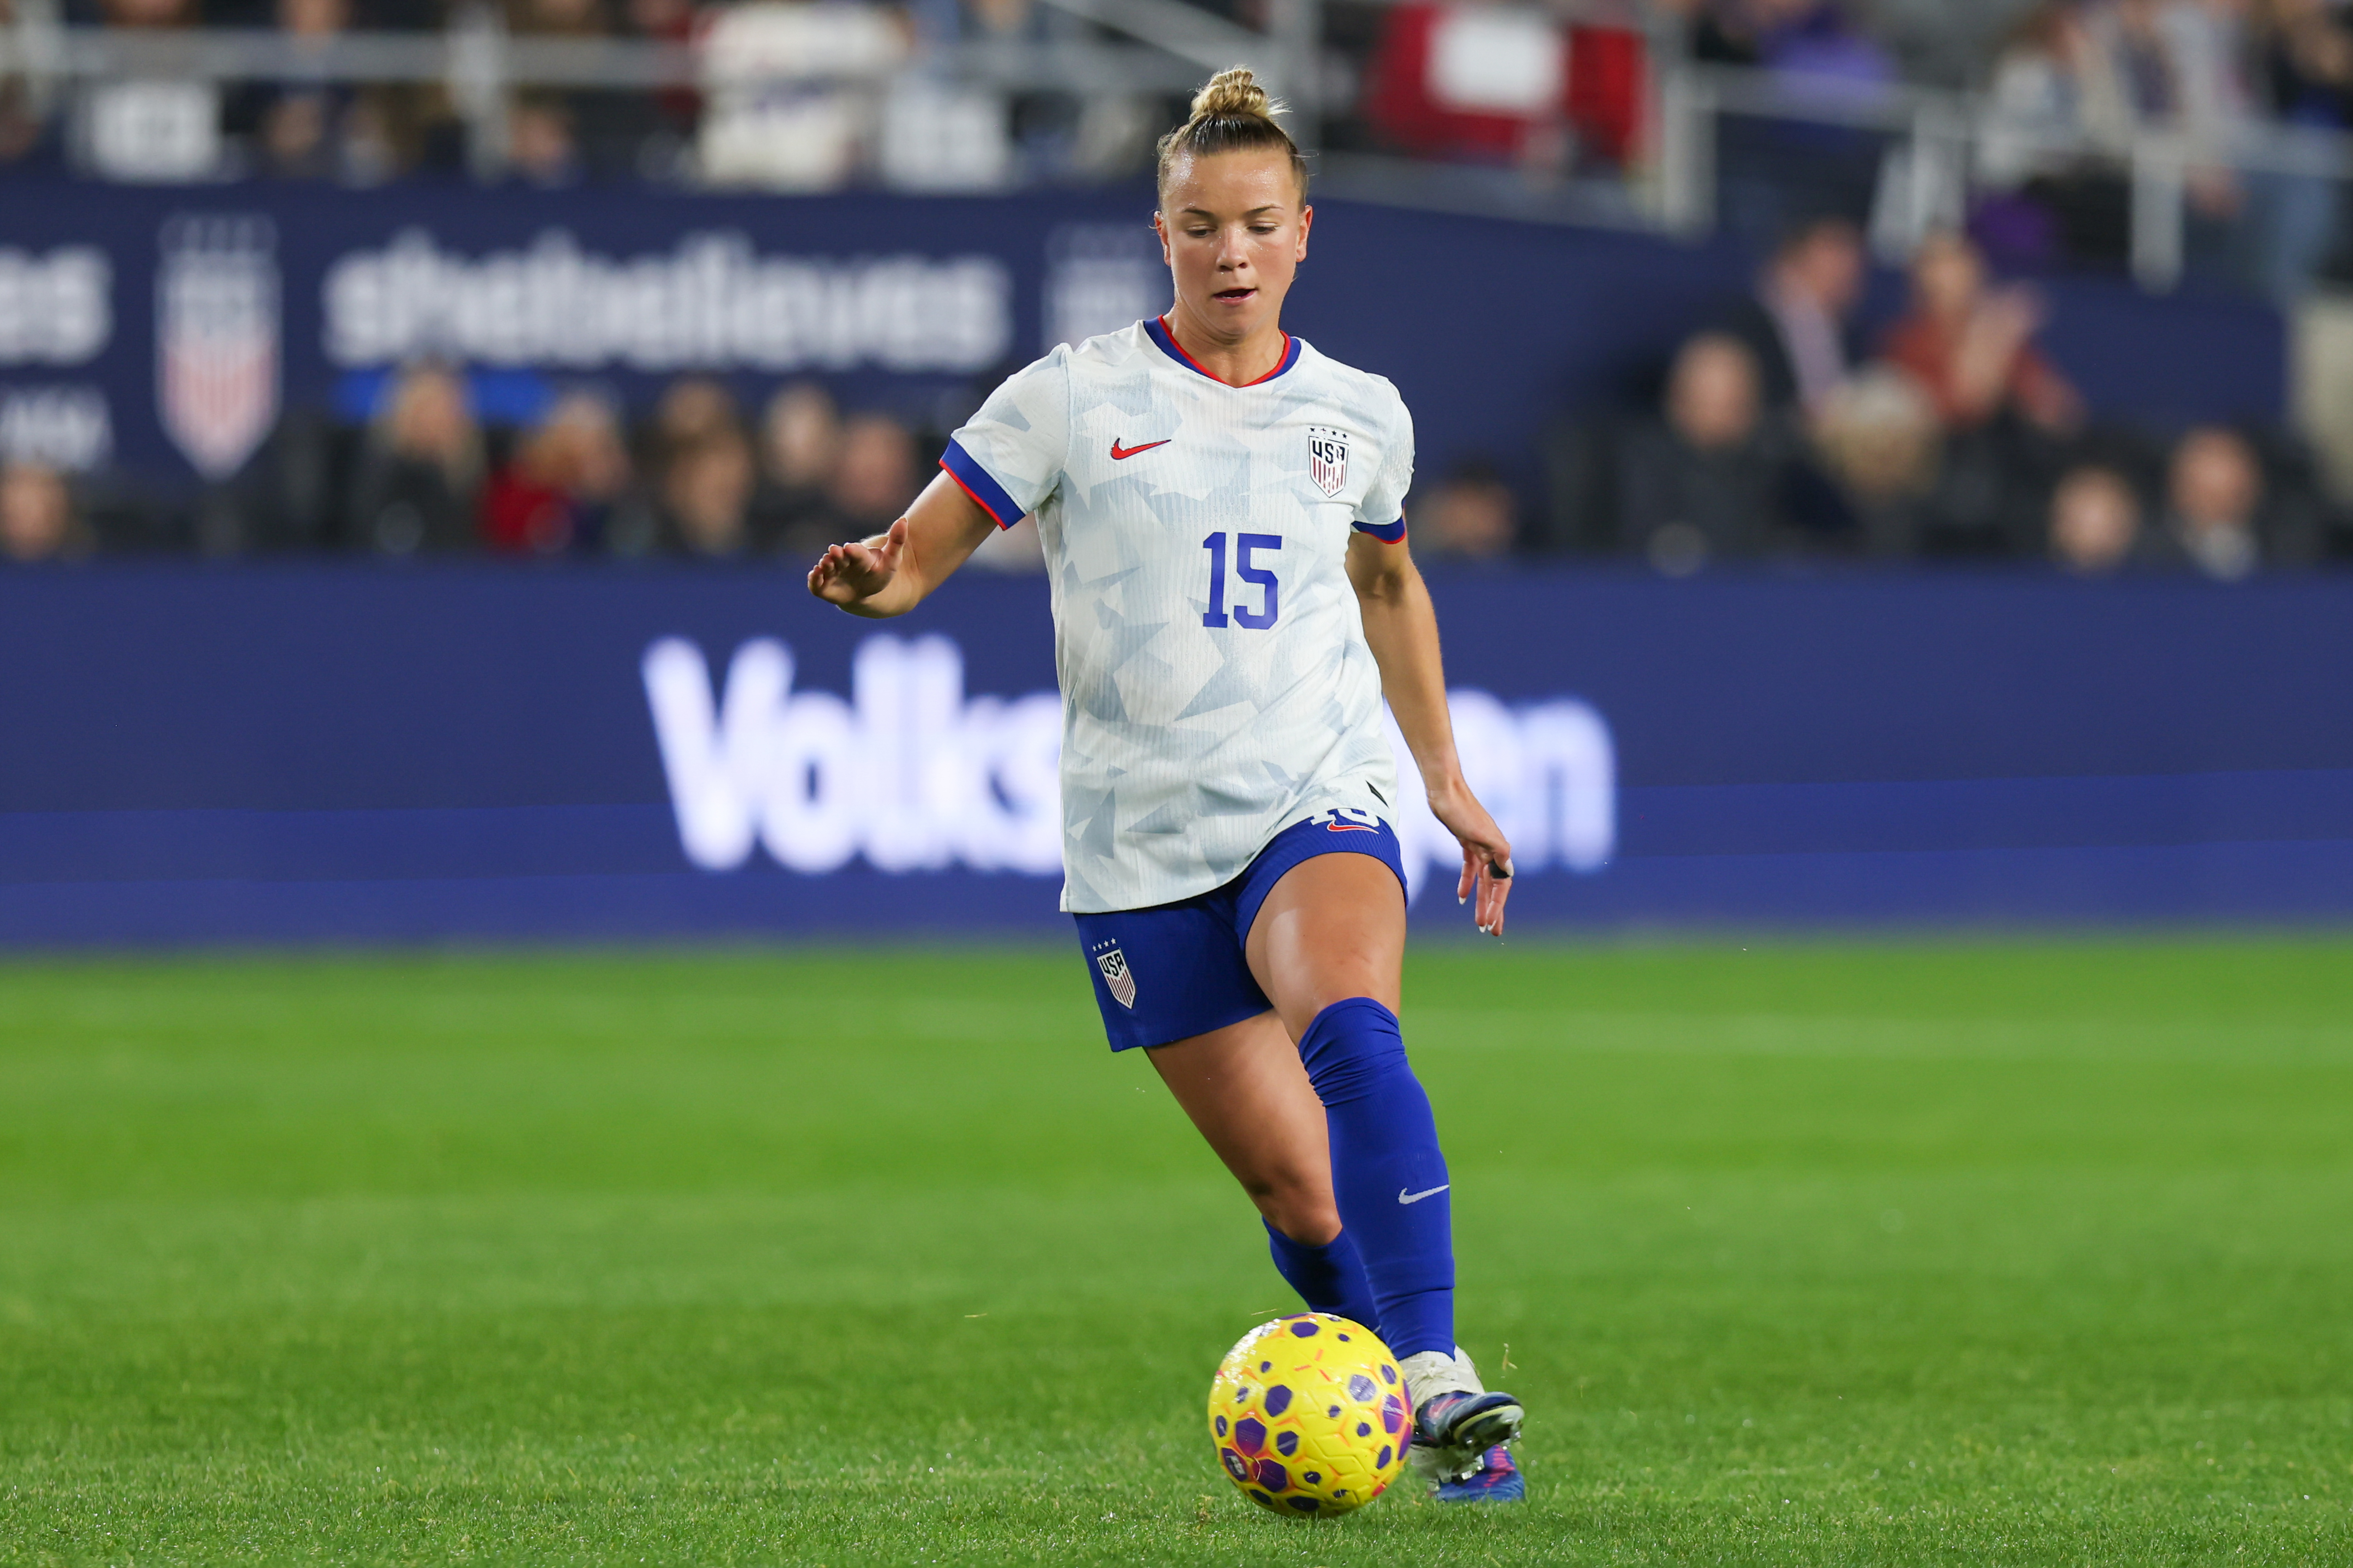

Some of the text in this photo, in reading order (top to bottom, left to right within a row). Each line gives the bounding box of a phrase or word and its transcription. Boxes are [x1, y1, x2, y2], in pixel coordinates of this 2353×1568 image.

[1312, 440, 1345, 464] USA
[1203, 532, 1282, 630] 15
[1099, 952, 1124, 977] USA
